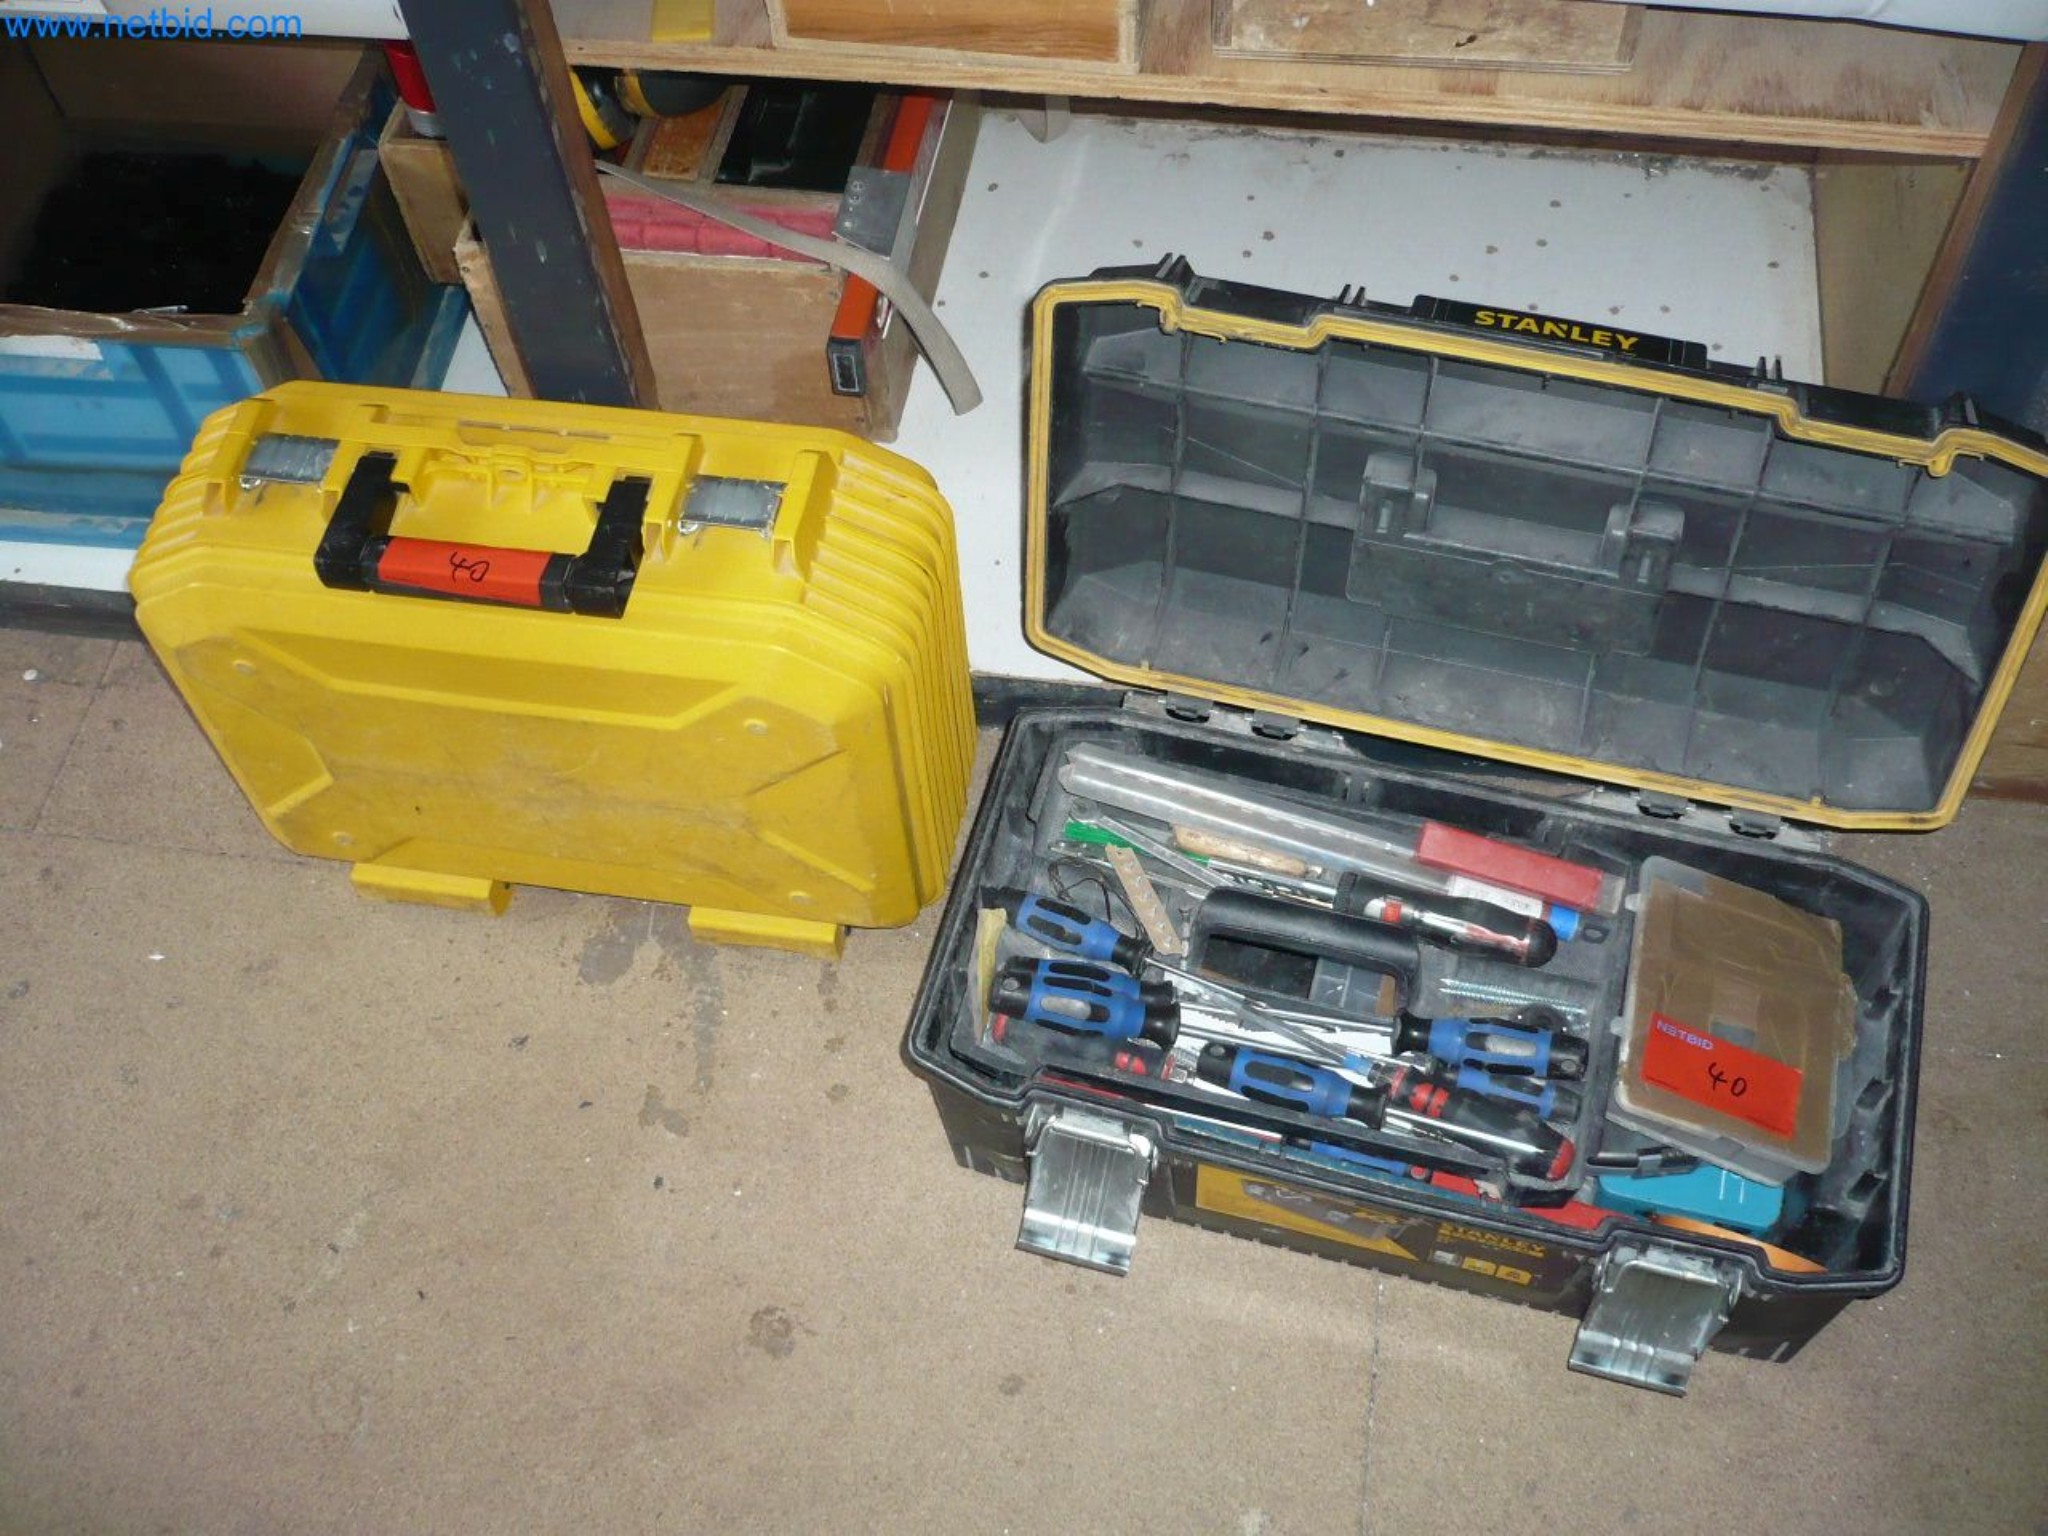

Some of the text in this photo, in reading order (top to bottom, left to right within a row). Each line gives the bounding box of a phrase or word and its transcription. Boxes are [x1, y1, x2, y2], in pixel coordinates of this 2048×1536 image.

[1474, 311, 1639, 350] STANLEY
[450, 551, 490, 583] 40
[1656, 1020, 1714, 1050] NETBID
[1707, 1062, 1748, 1097] 40
